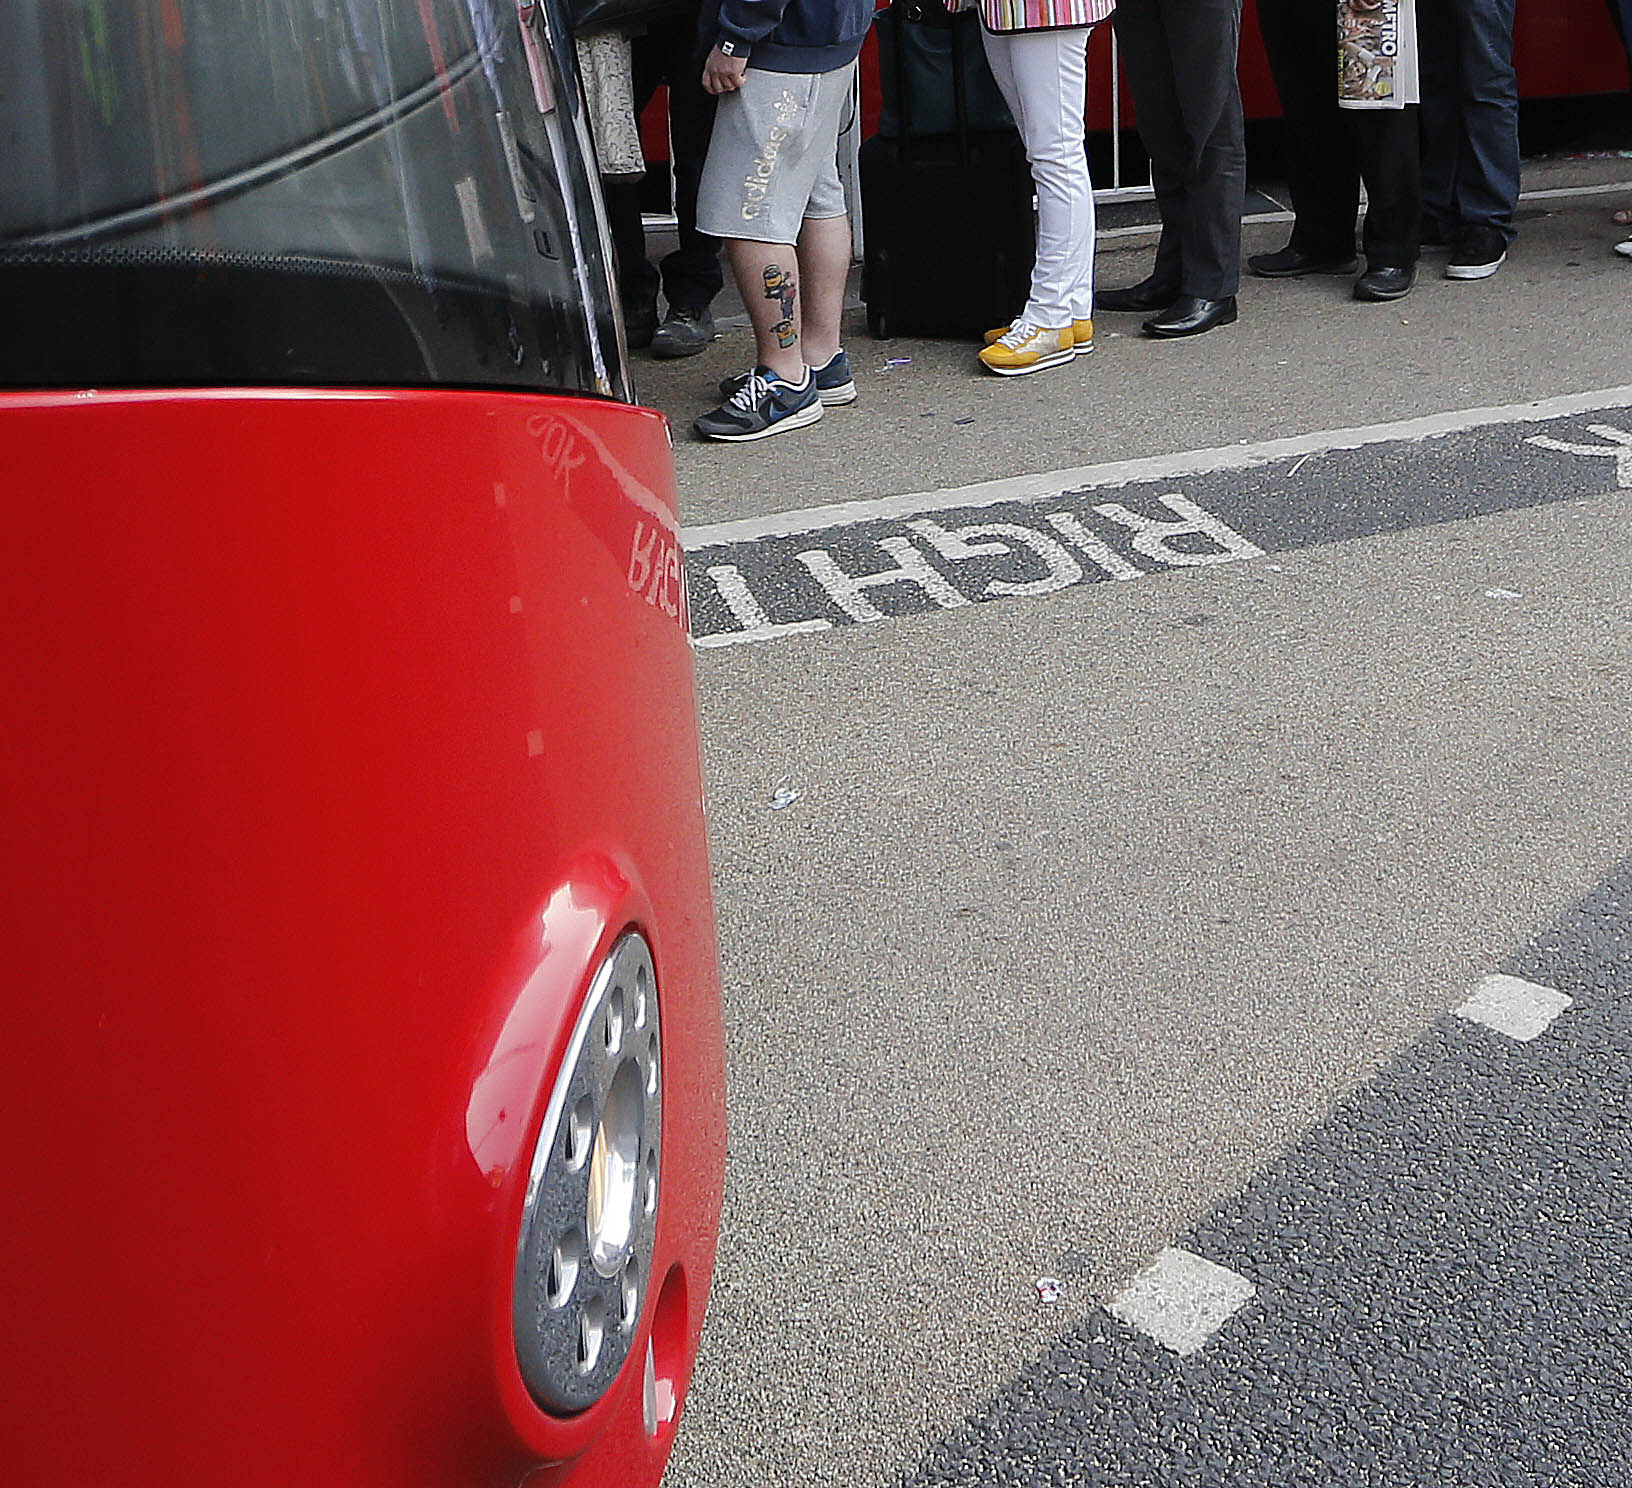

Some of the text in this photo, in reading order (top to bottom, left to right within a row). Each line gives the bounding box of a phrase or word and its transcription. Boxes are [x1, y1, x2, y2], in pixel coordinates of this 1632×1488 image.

[1381, 0, 1398, 57] METRO
[740, 125, 788, 222] adidas
[692, 492, 1267, 648] RIGHT
